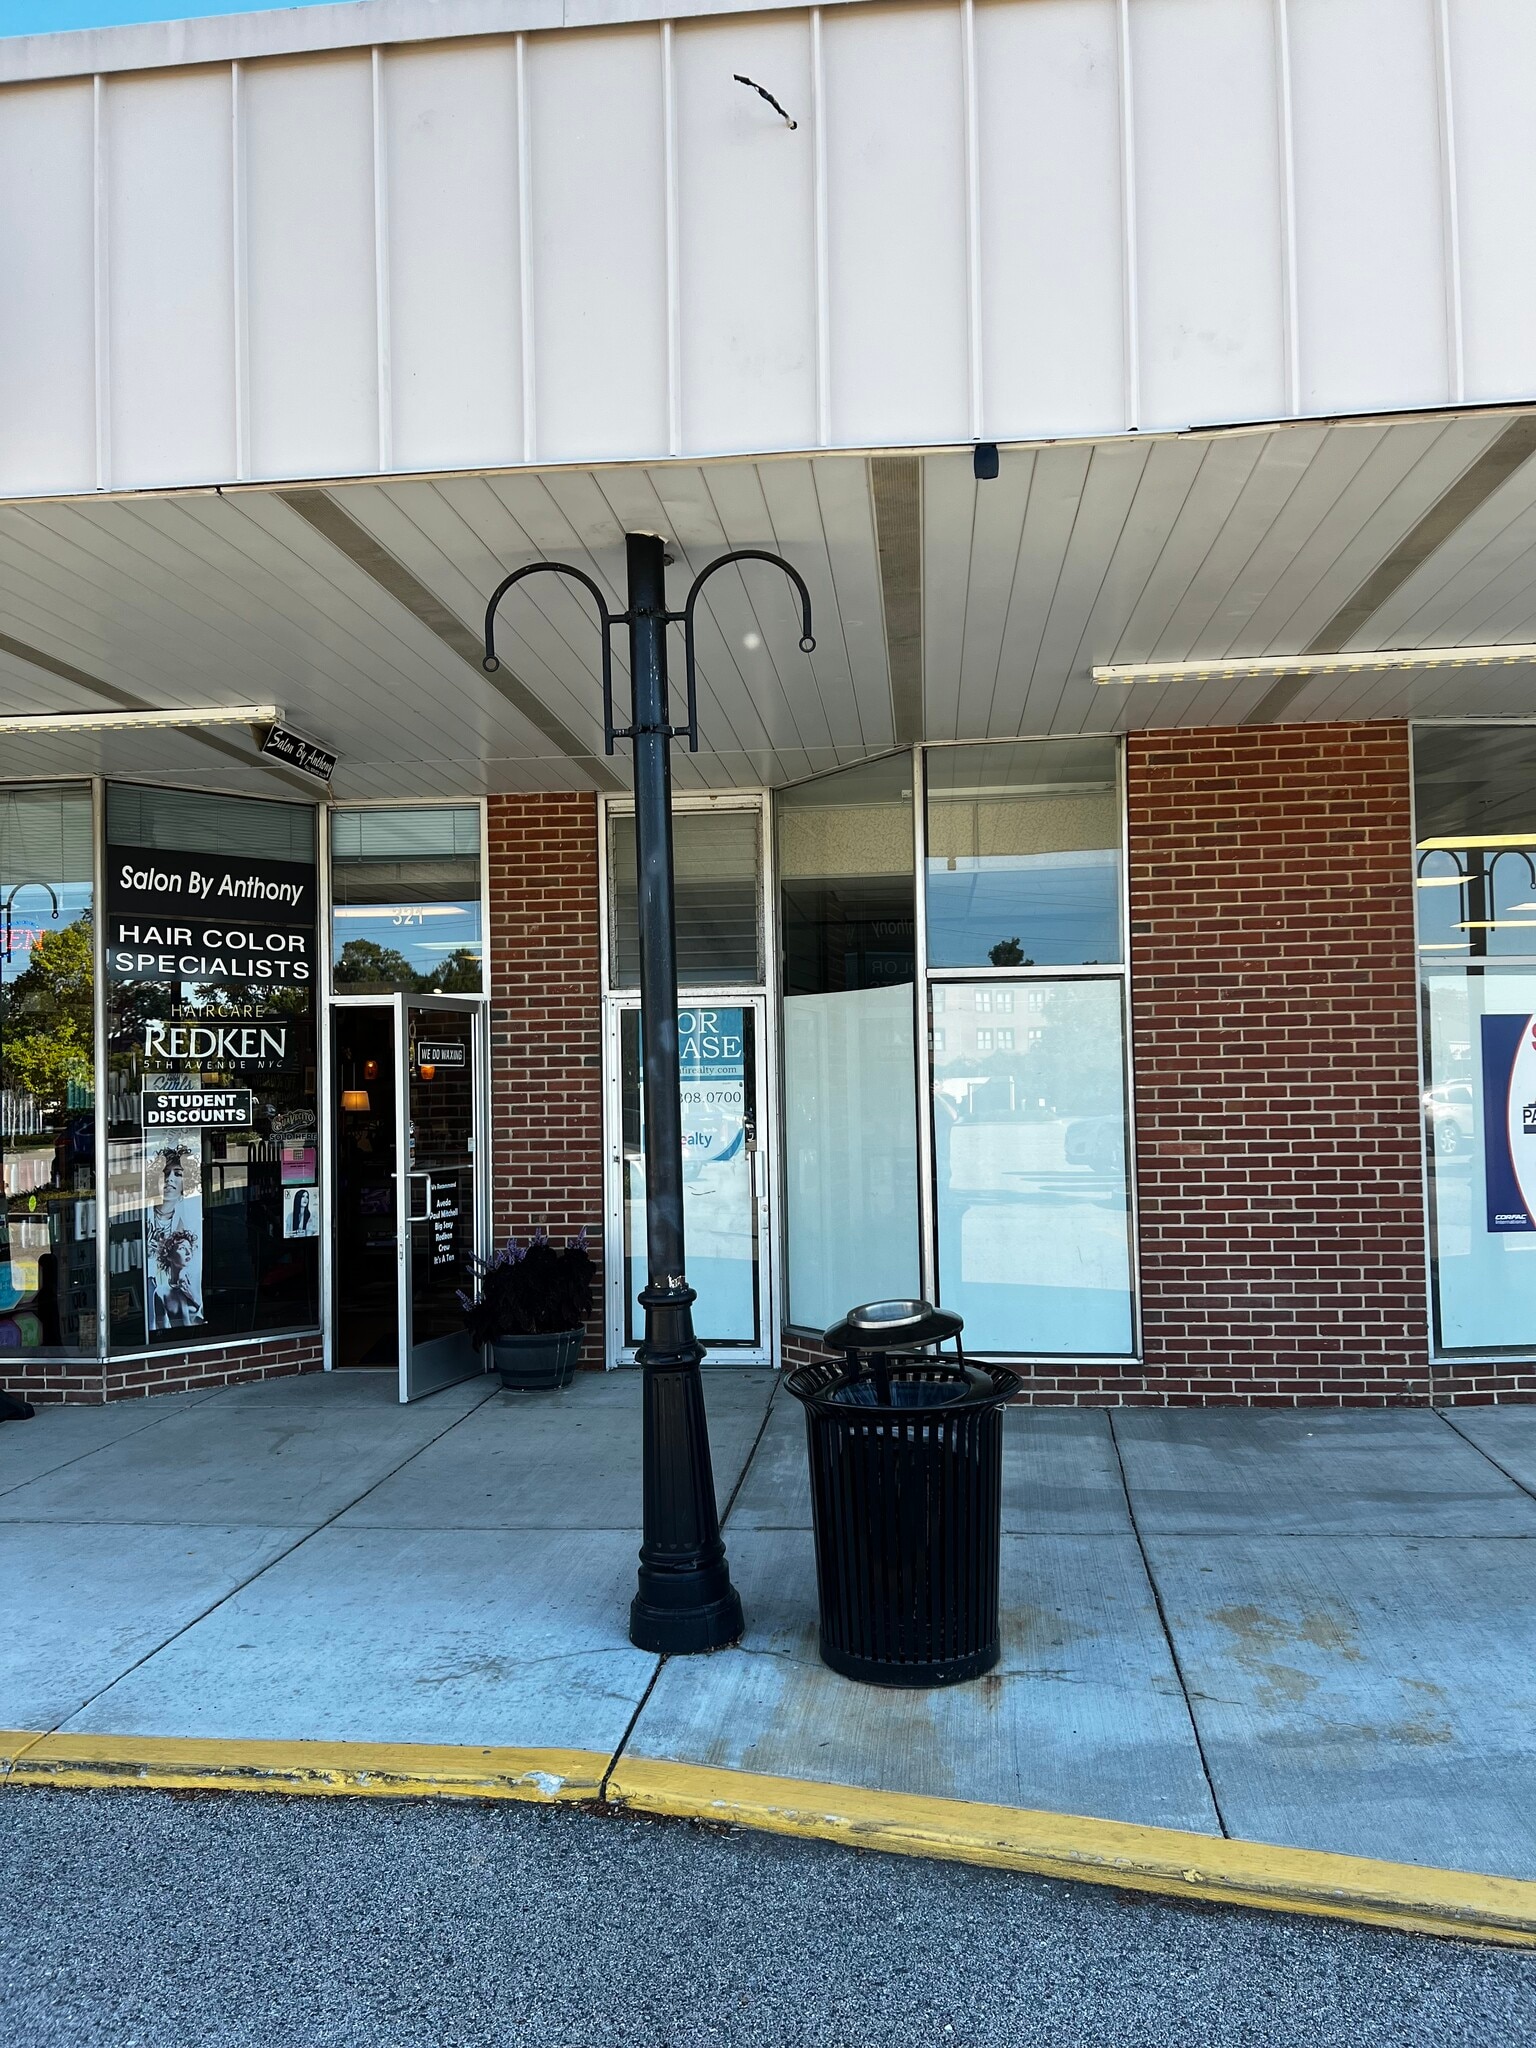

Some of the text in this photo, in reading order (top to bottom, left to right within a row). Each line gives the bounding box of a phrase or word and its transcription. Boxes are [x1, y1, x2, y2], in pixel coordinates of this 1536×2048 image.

[266, 731, 295, 754] Salon
[296, 742, 307, 765] By
[303, 749, 333, 778] Anthony
[120, 865, 304, 906] Salon By Anthony
[392, 906, 423, 925] 321
[119, 924, 306, 953] HAIR COLOR
[115, 952, 310, 980] SPECIALISTS
[171, 1004, 264, 1018] HAIRCARE
[677, 1012, 719, 1034] OR
[144, 1026, 287, 1058] REDKEN
[679, 1036, 742, 1059] ASE
[421, 1048, 463, 1061] WE DO WAXING
[143, 1059, 284, 1070] 5TH AVENUE NYC
[680, 1065, 737, 1076] firealty.com
[157, 1094, 237, 1108] STUDENT
[680, 1091, 742, 1104] 08.0700
[147, 1108, 246, 1124] DISCOUNTS
[269, 1132, 317, 1141] SOLD HERE
[680, 1131, 712, 1148] ealty
[429, 1207, 459, 1220] Paul Mitchell
[434, 1222, 443, 1231] Big
[435, 1232, 453, 1242] Redken
[438, 1243, 451, 1252] Crew
